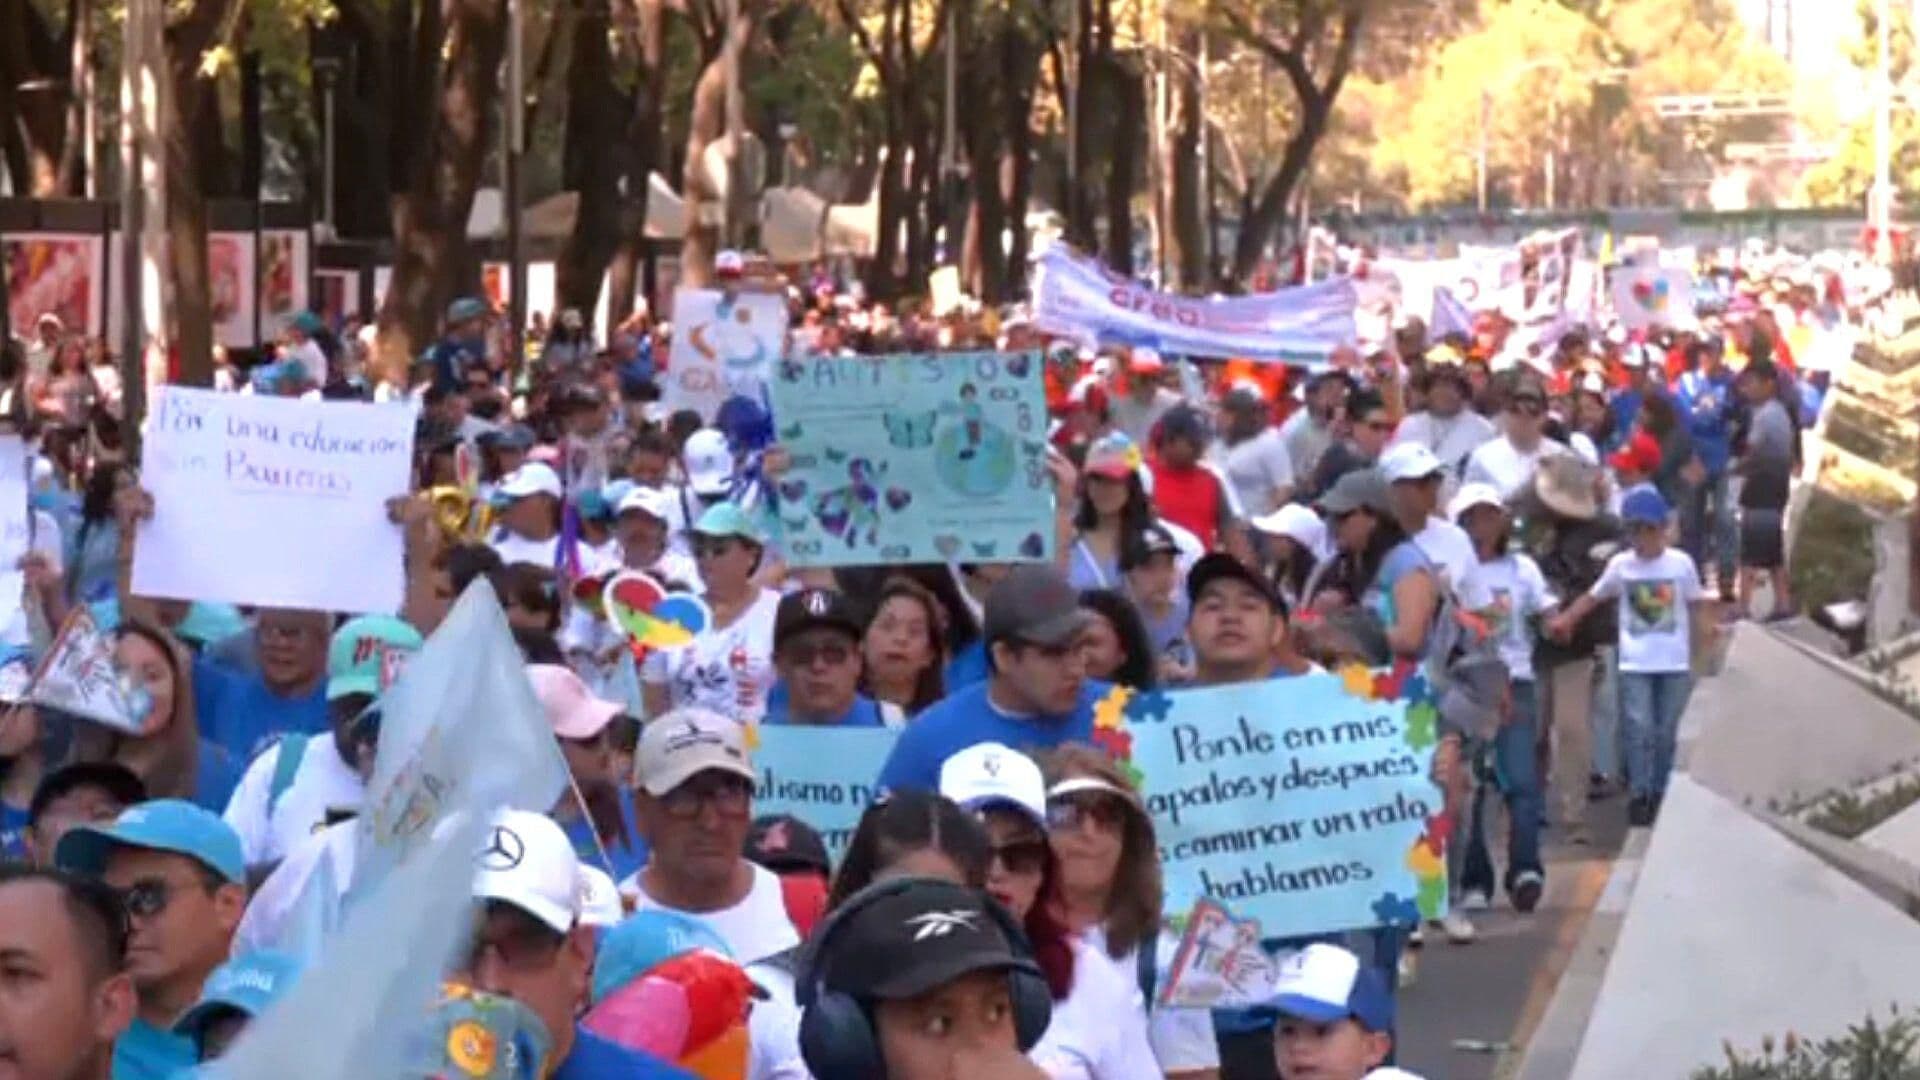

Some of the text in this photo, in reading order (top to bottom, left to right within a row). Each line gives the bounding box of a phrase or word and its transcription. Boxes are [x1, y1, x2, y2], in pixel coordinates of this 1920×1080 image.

[1282, 727, 1326, 750] en
[1331, 715, 1398, 744] mis
[1146, 770, 1257, 827] apatos
[1260, 772, 1277, 801] y
[1173, 819, 1304, 862] caminar
[1311, 812, 1357, 837] un
[1199, 861, 1374, 899] hablamos
